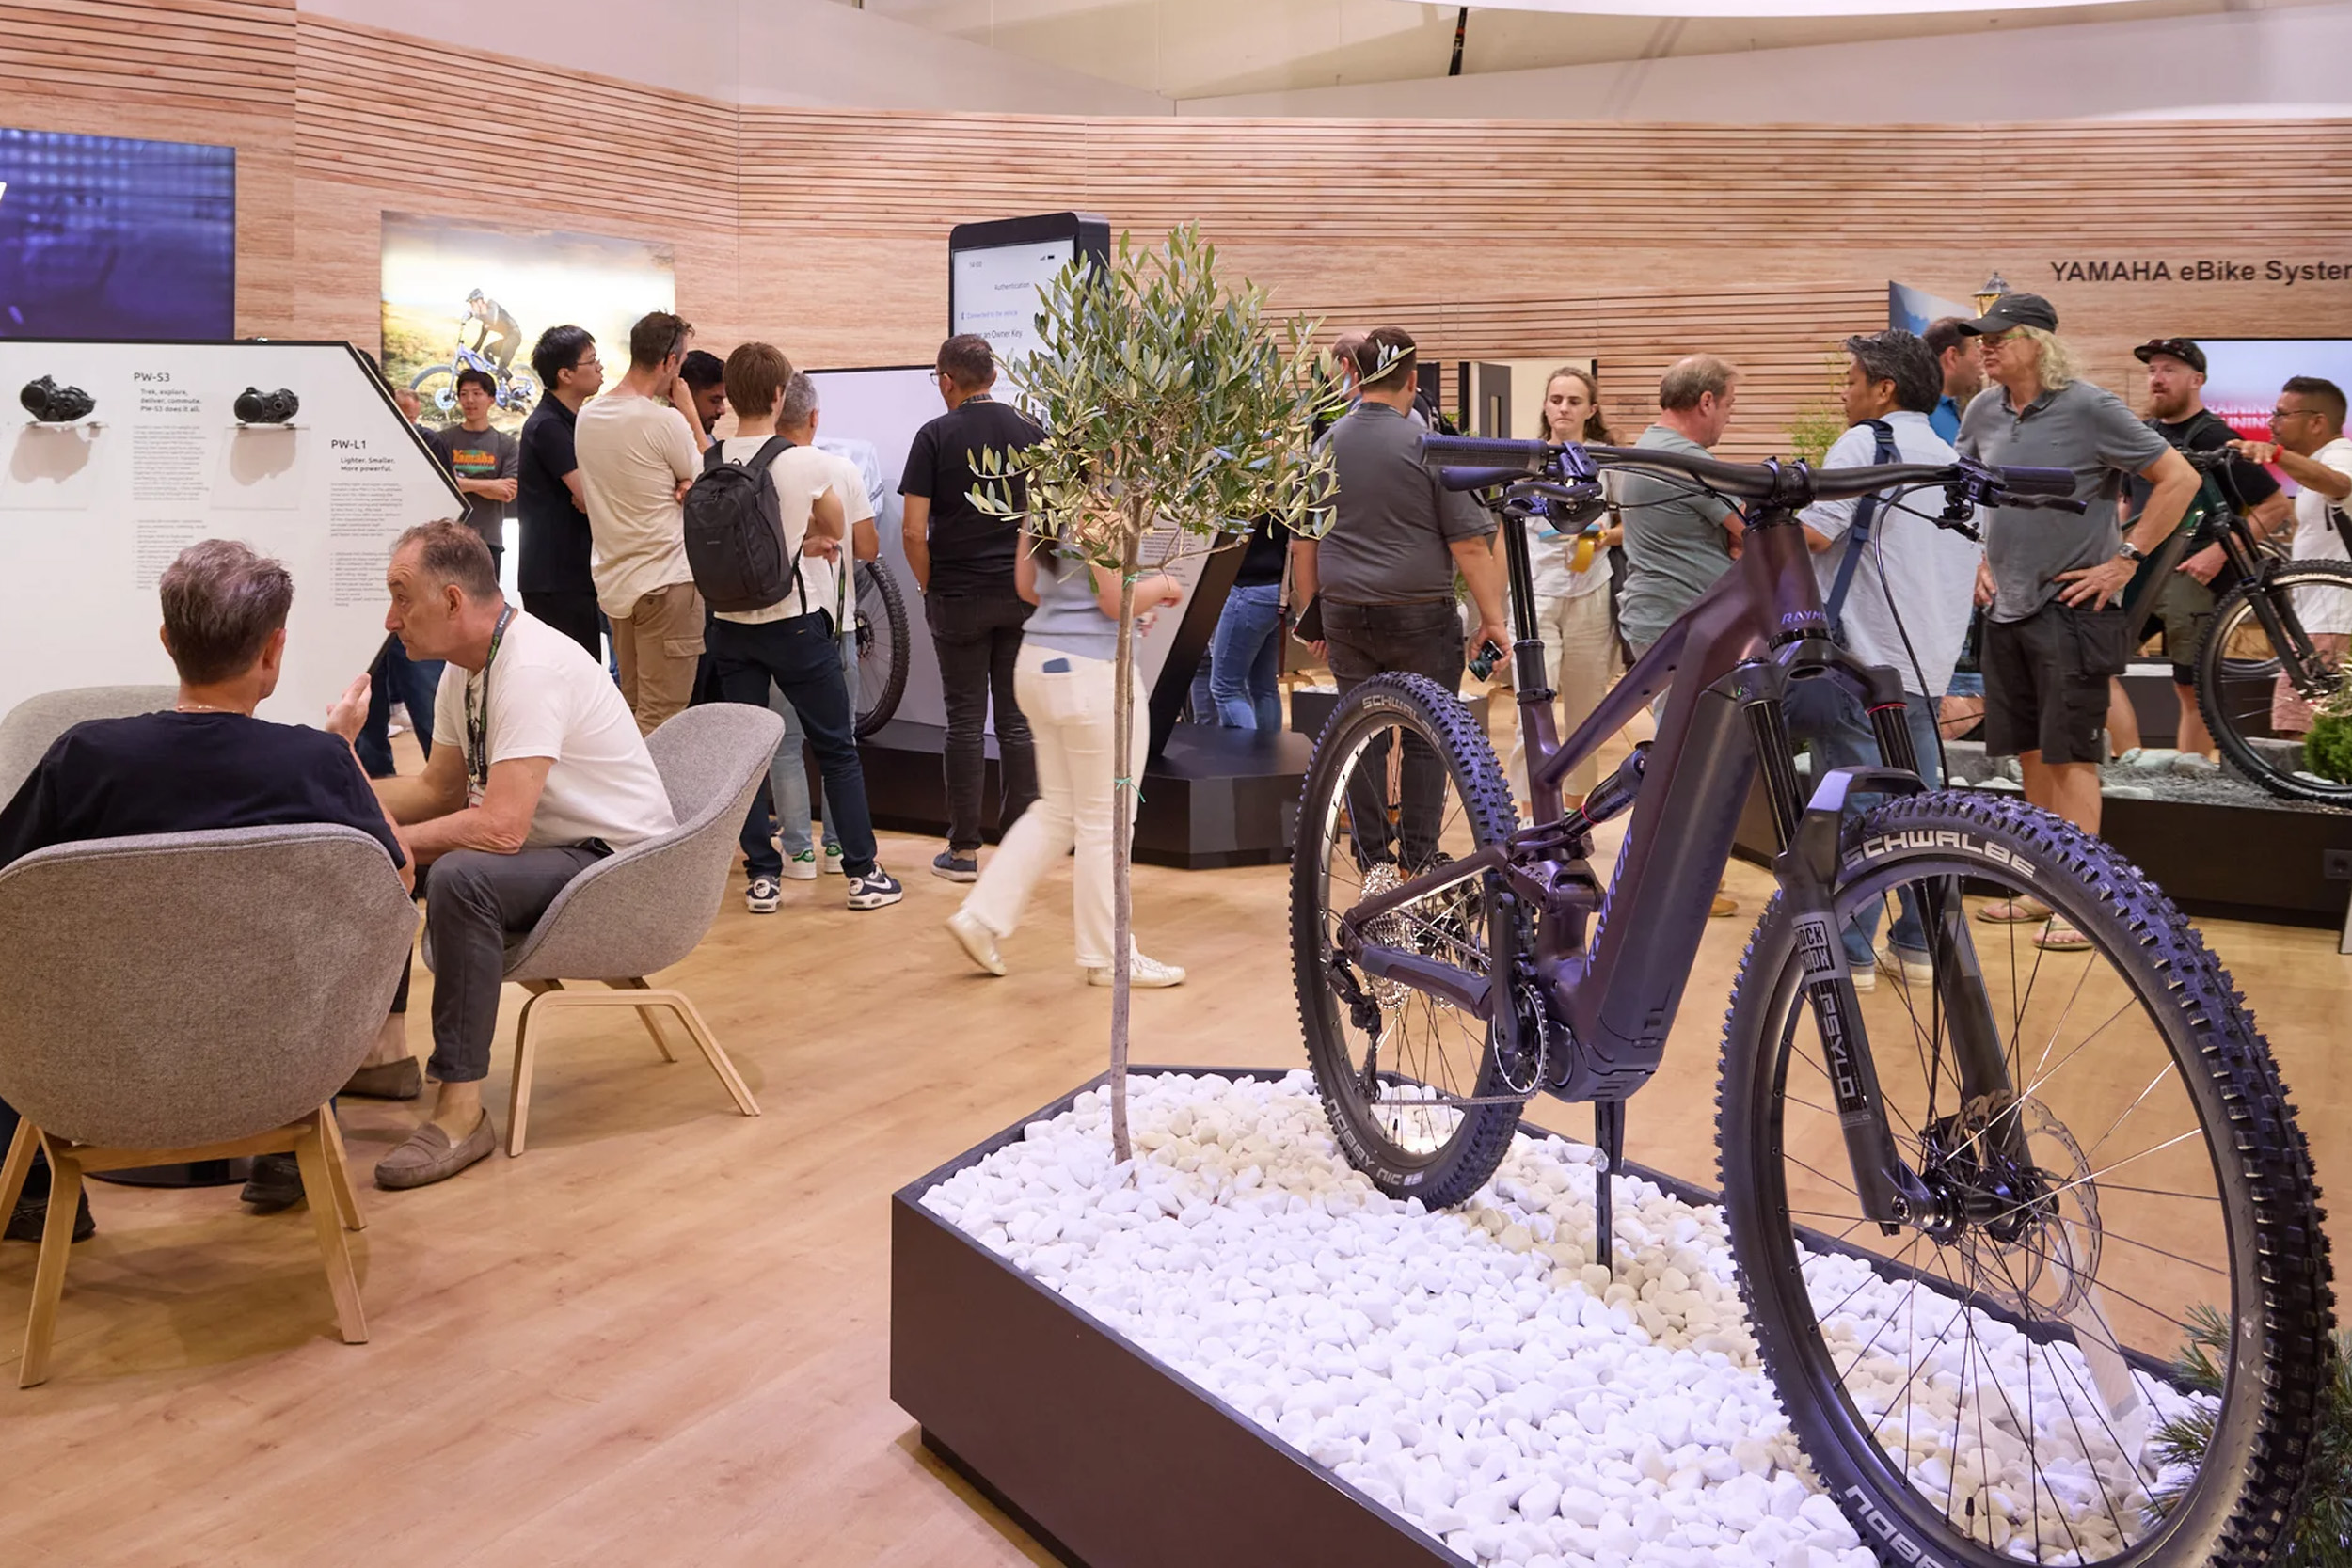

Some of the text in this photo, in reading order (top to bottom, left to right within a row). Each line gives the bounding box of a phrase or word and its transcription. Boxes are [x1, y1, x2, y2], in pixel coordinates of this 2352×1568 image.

[2051, 261, 2171, 281] YAMAHA
[2180, 261, 2255, 281] eBike
[991, 330, 1010, 339] Owner
[1011, 329, 1023, 339] Key
[134, 372, 170, 382] PW-S3
[331, 439, 366, 449] PW-L1
[1362, 695, 1440, 747] SCHWALBE
[1841, 830, 2036, 879] SCHWALBE
[1796, 926, 1823, 947] OCK
[1819, 992, 1856, 1099] PSYLO
